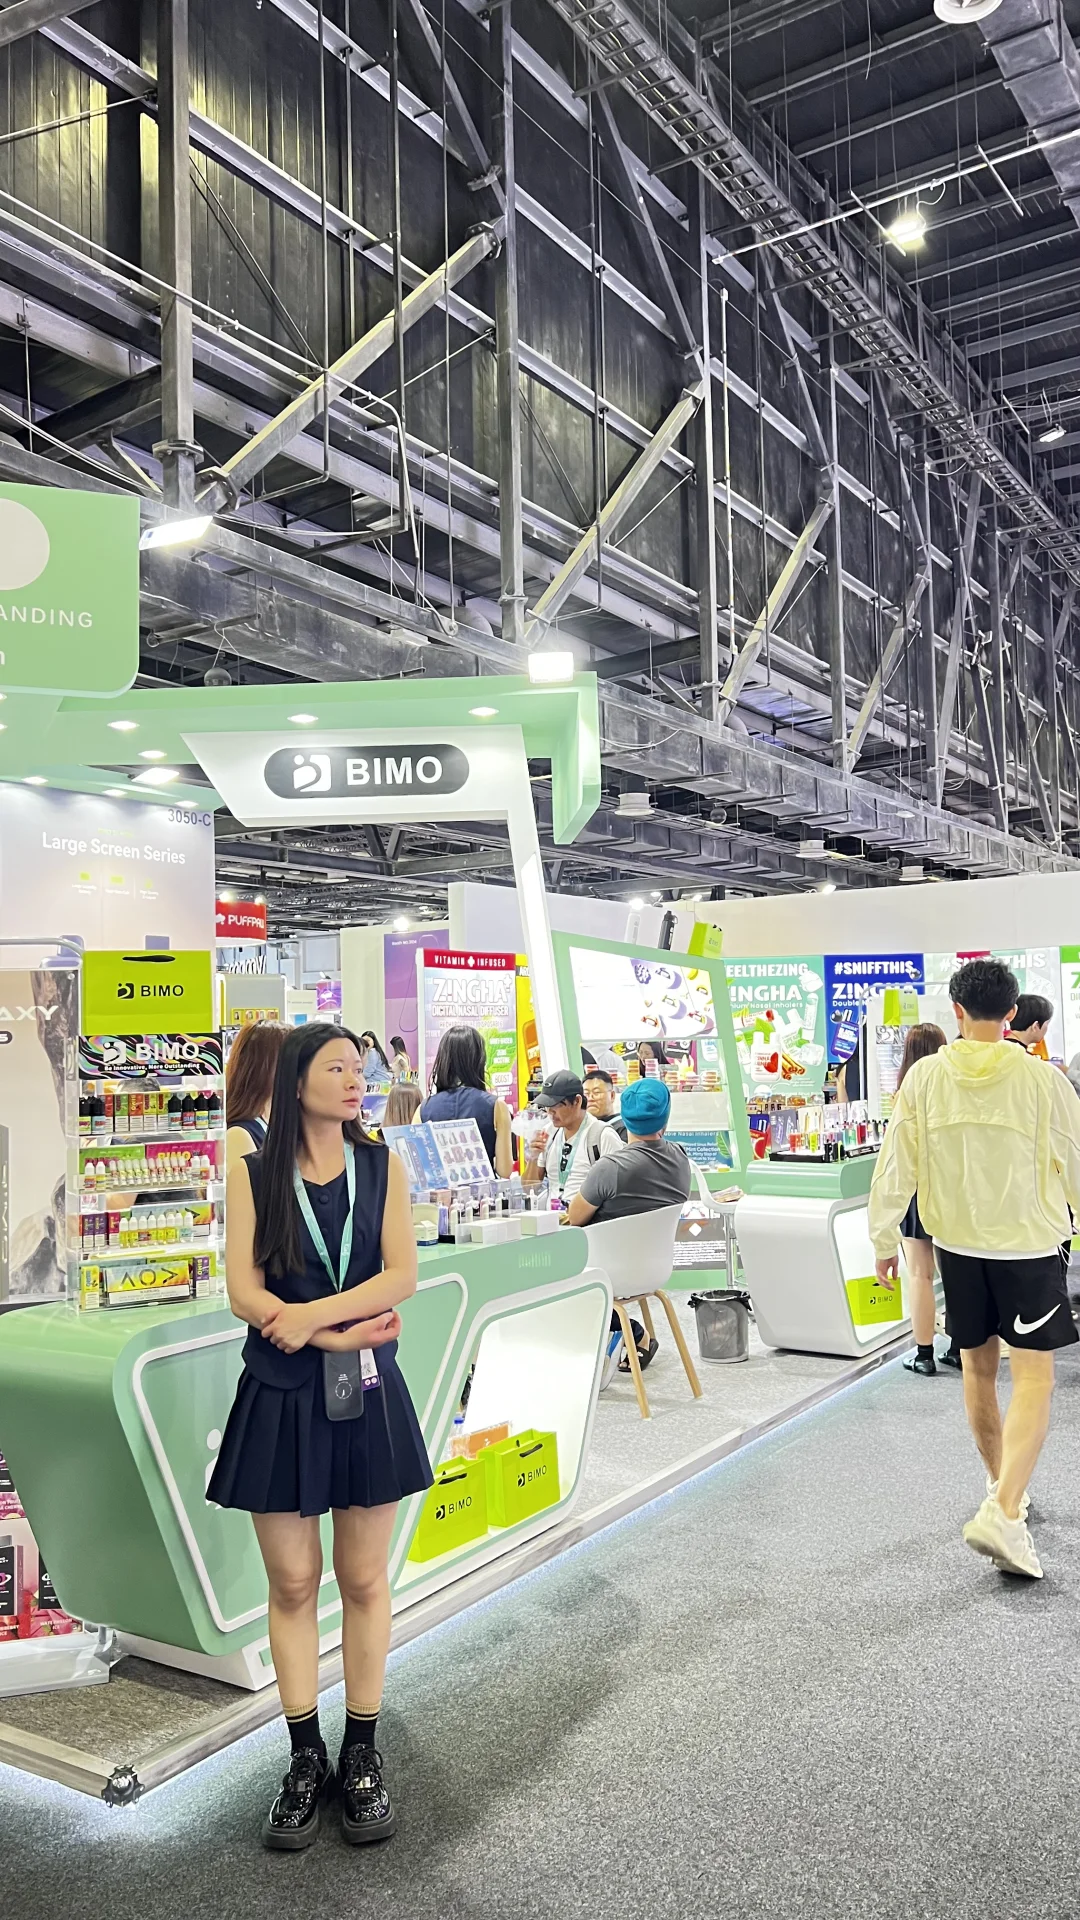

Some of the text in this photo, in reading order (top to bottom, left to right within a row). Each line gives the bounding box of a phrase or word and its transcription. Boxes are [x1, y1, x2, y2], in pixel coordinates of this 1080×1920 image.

[346, 756, 443, 786] BIMO
[168, 808, 212, 827] 3050-C
[42, 831, 88, 856] Large
[91, 837, 141, 860] Screen
[143, 845, 186, 865] Series
[434, 954, 506, 967] VITAMIN INFUSED
[833, 960, 914, 975] #SNIFFTHIS
[724, 963, 808, 978] EELTHEZING
[140, 984, 185, 997] BIMO
[432, 1004, 509, 1017] DIGITAL NASAL DIFFUSER
[136, 1042, 200, 1061] BIMO
[877, 1295, 894, 1304] BIMO
[527, 1464, 547, 1482] BIMO
[448, 1496, 473, 1515] BIMO
